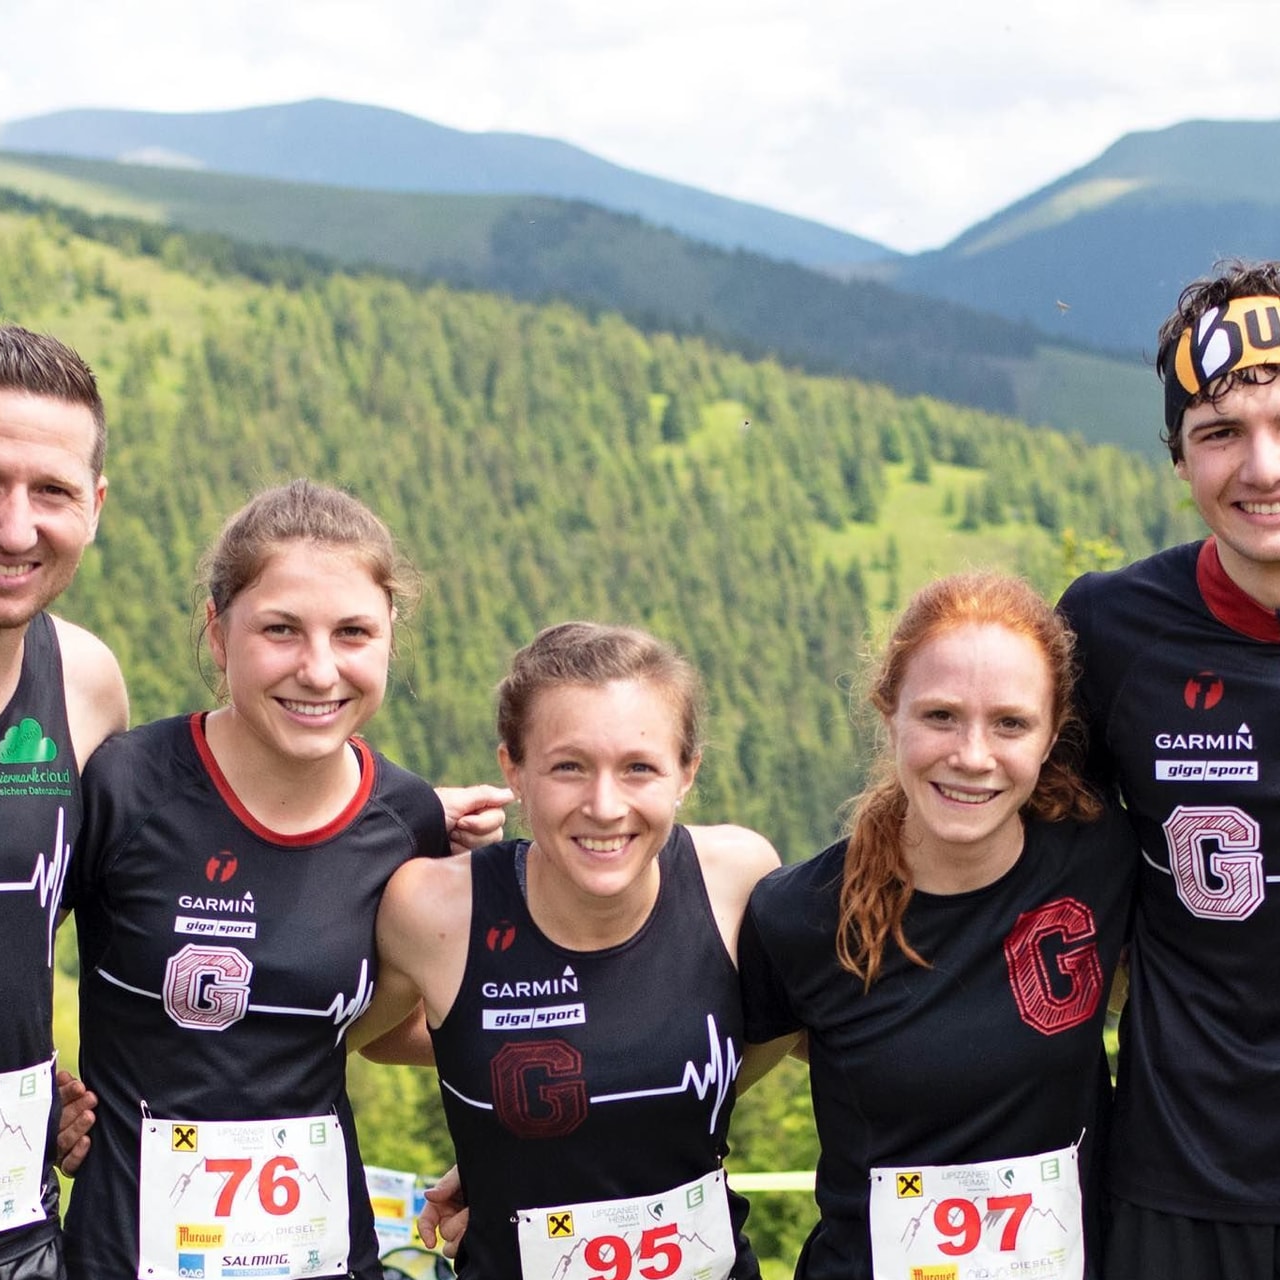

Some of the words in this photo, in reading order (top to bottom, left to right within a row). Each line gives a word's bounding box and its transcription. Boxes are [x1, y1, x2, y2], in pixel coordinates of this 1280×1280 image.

[1156, 734, 1253, 749] GARMIN
[1162, 805, 1265, 921] G
[179, 895, 254, 913] GARMIN
[163, 943, 253, 1031] G
[482, 977, 578, 998] GARMIN
[1004, 897, 1104, 1036] G
[205, 1156, 300, 1217] 76
[179, 1227, 222, 1246] Murauer
[934, 1193, 1032, 1256] 97
